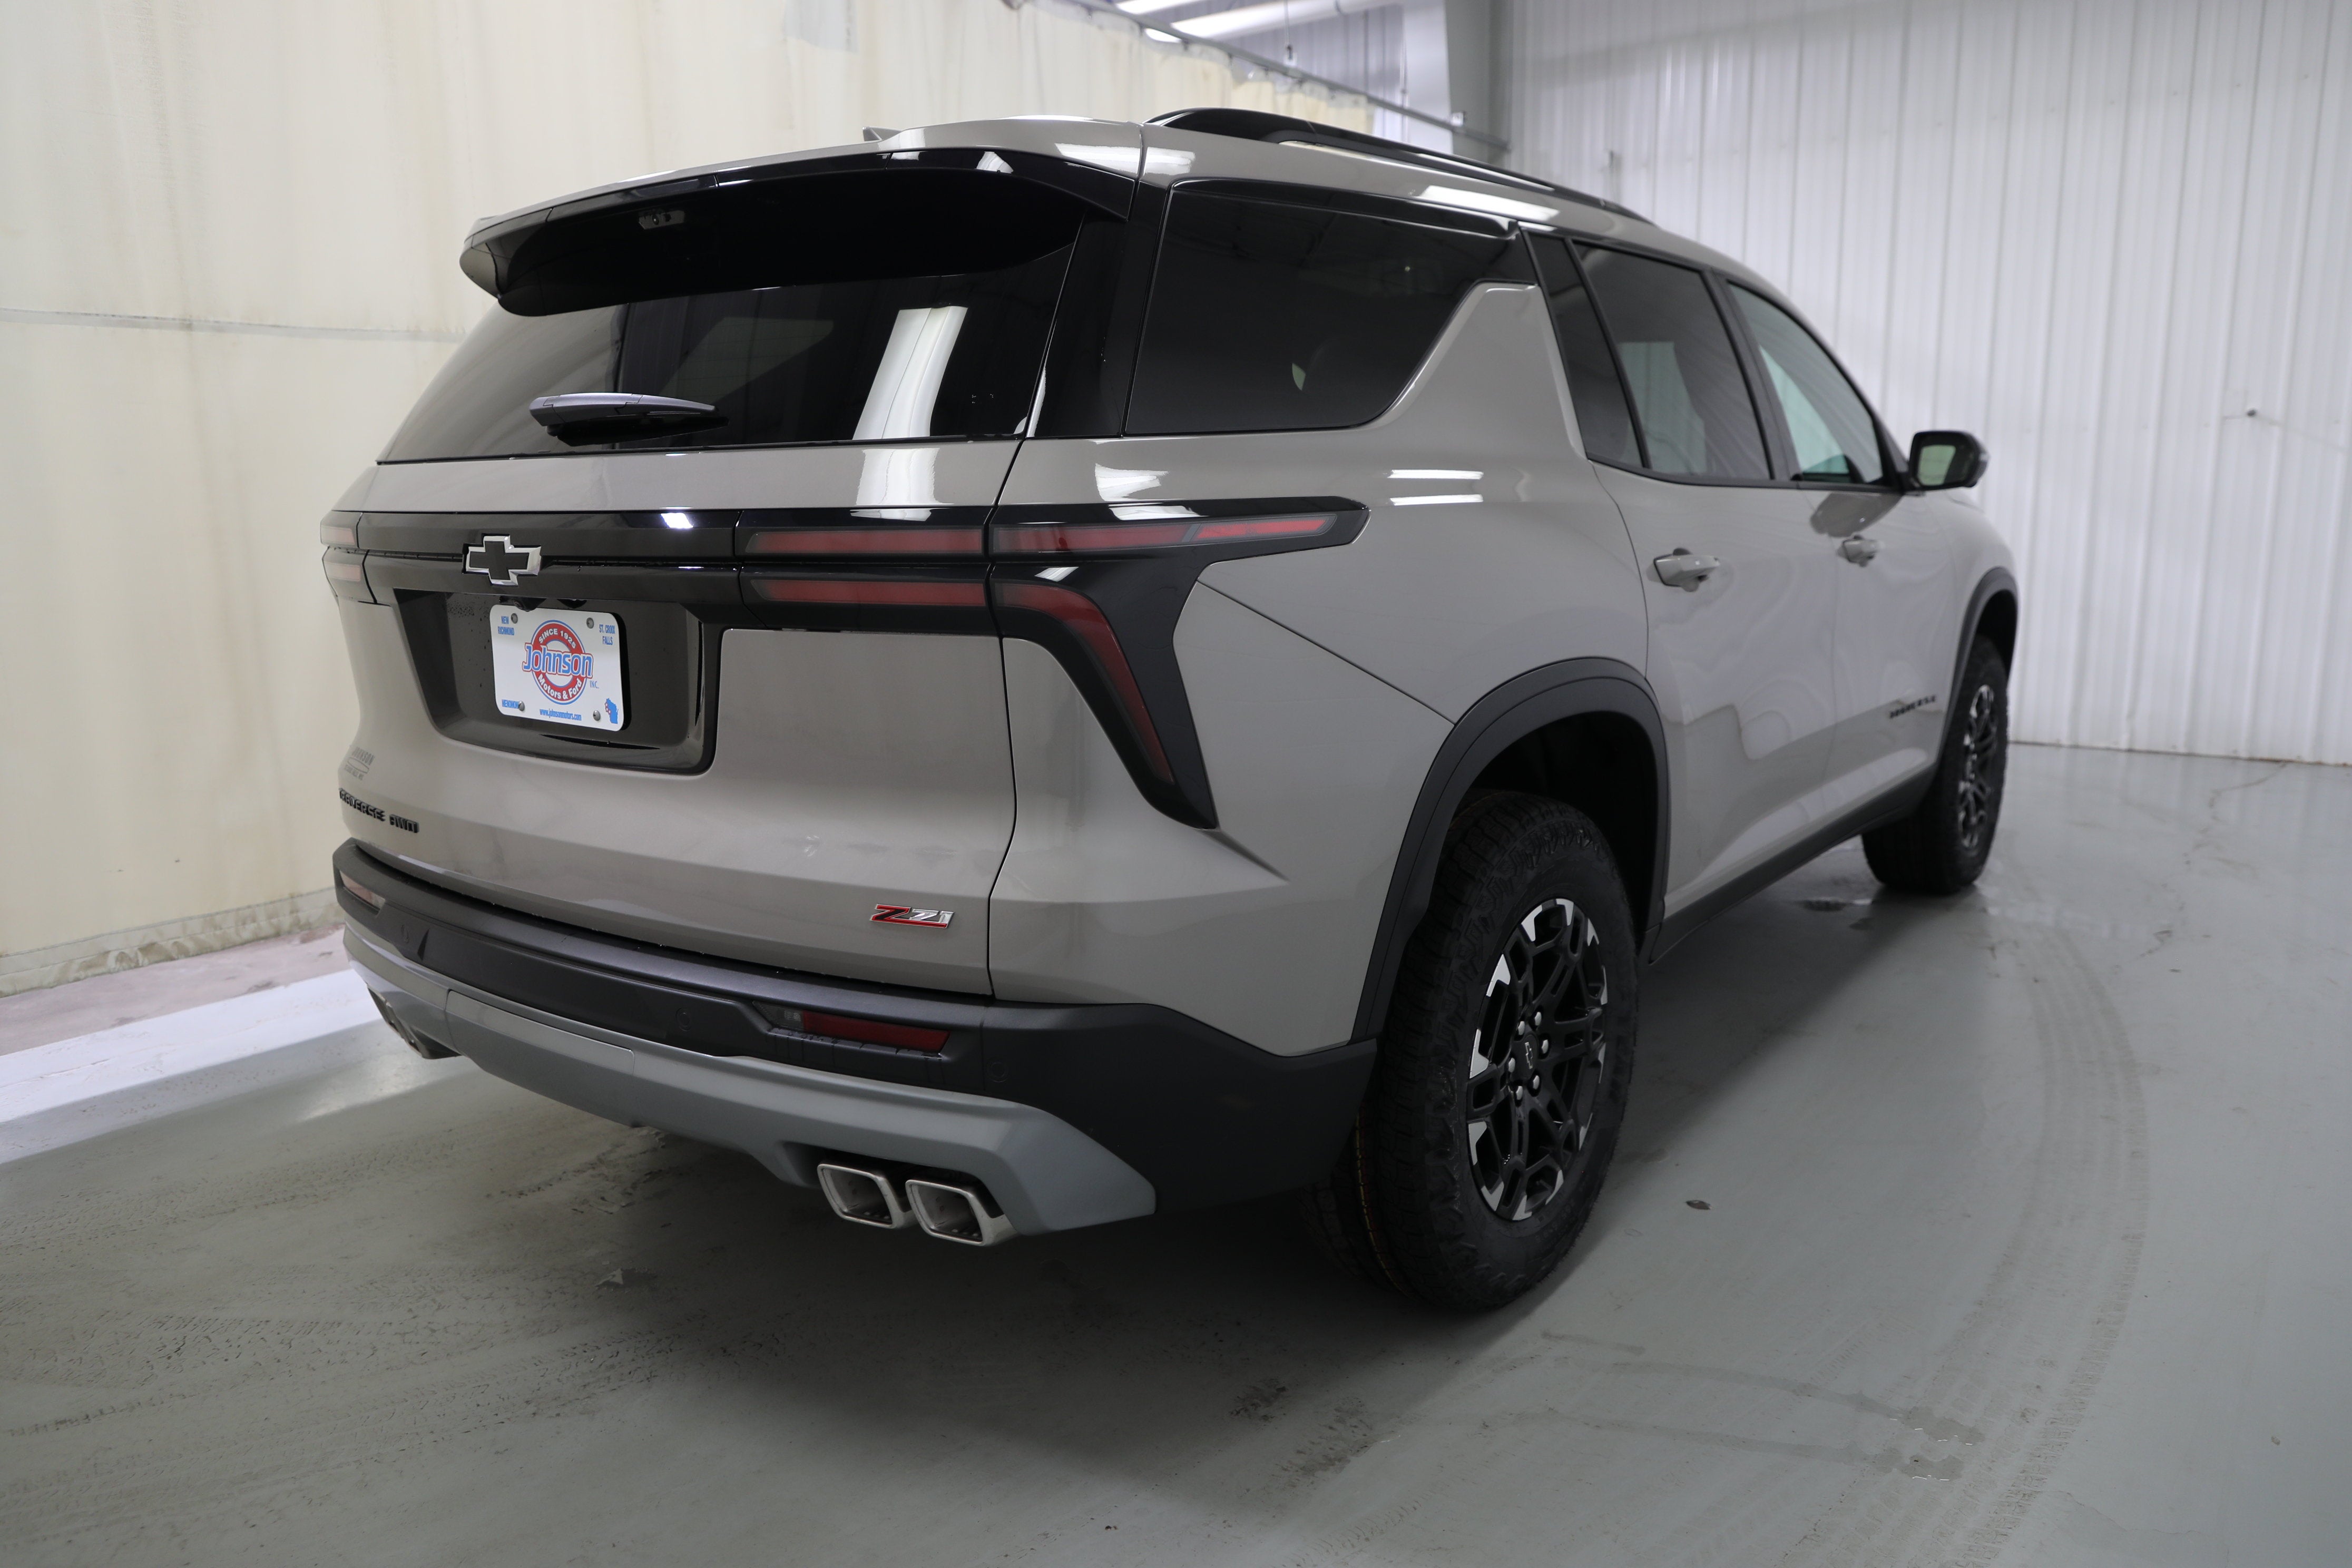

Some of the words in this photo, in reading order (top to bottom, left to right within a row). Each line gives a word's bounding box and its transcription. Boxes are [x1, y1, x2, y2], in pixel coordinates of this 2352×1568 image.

[538, 628, 558, 643] SINCE
[560, 631, 576, 649] 1925
[602, 635, 613, 645] FALLS
[522, 644, 593, 678] Johnson
[538, 674, 562, 699] Motors
[562, 690, 569, 700] &
[568, 678, 583, 698] Ford
[590, 680, 600, 689] INC.
[502, 699, 519, 709] MENOMON
[539, 708, 582, 721] www.johnsonmotors.com
[869, 904, 955, 929] Z71
